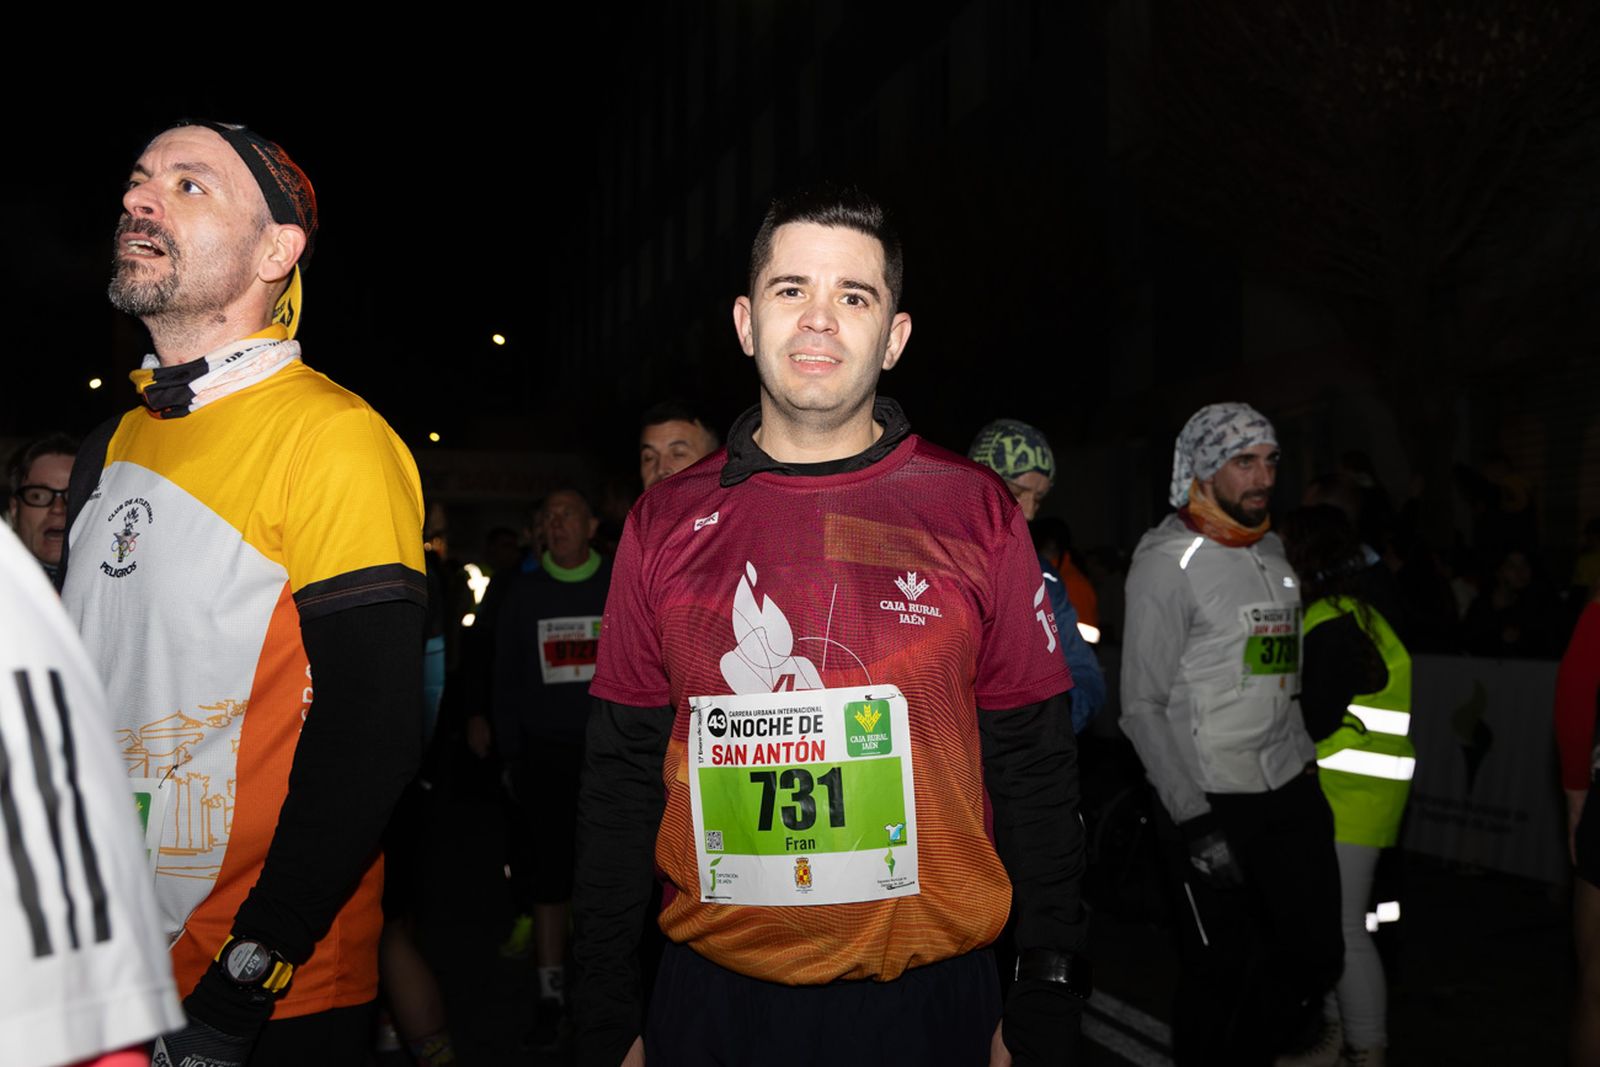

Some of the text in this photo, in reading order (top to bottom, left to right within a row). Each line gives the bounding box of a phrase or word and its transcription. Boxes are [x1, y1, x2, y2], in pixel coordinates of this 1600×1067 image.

[107, 498, 154, 524] CLUB DE ATLETISMO
[99, 560, 137, 578] PELIGROS
[880, 600, 942, 618] CAJA RURAL
[899, 613, 925, 625] JAÉN
[753, 709, 776, 717] URBANA
[777, 706, 822, 715] INTERNACIONAL
[708, 715, 726, 729] 43
[730, 715, 823, 737] NOCHE DE
[850, 735, 866, 743] CAJA
[711, 736, 825, 765] SAN ANTÓN
[750, 767, 846, 831] 731
[785, 837, 816, 851] Fran
